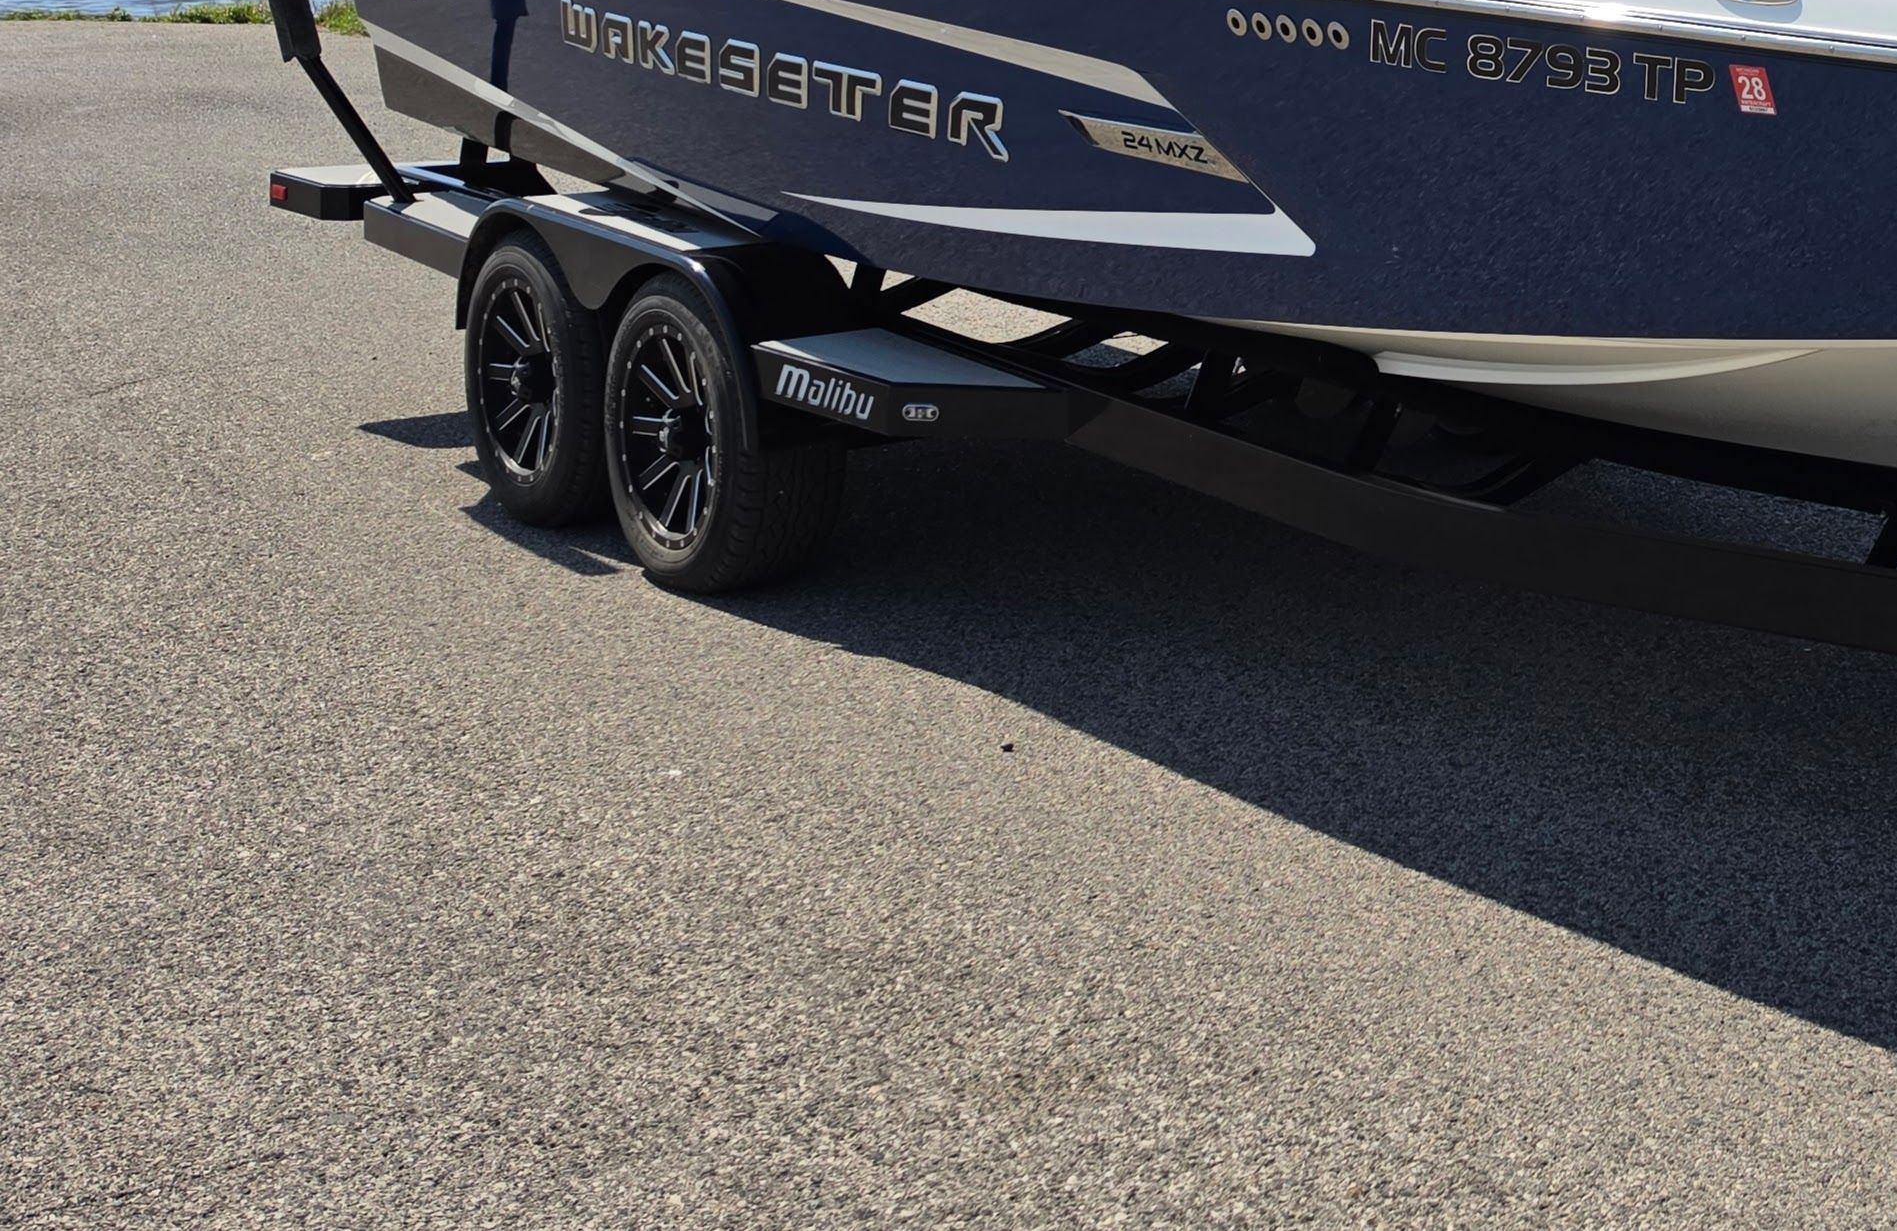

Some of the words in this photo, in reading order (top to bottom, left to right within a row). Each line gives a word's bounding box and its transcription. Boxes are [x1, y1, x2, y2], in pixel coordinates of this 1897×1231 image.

[1369, 19, 1447, 73] MC
[1466, 33, 1621, 95] 8793
[1633, 52, 1716, 104] TP
[1737, 75, 1767, 101] 28
[1121, 130, 1153, 153] 24
[1154, 137, 1208, 164] MXZ
[775, 363, 875, 420] Malibu
